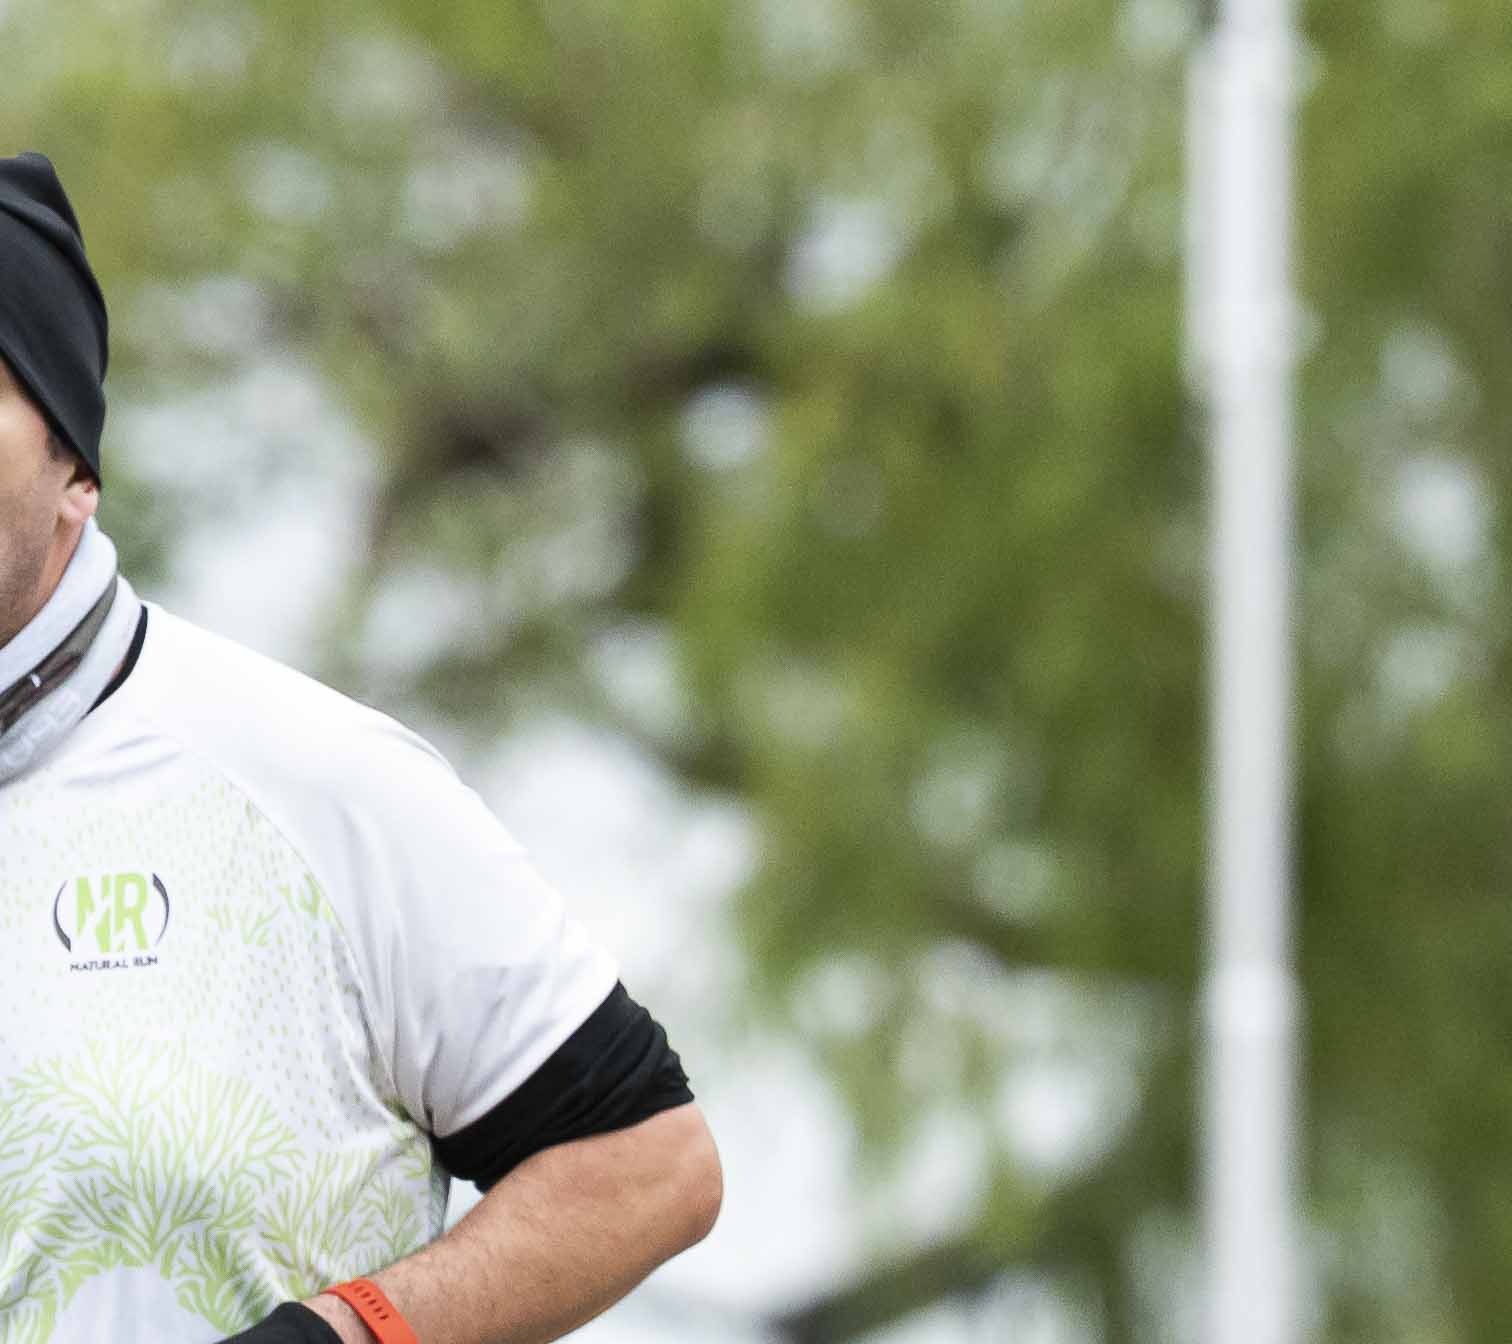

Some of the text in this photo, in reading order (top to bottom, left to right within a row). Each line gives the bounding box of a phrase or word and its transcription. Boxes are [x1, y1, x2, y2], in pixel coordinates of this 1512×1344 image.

[76, 873, 149, 953] NR
[70, 955, 159, 972] NATURAL RUN
